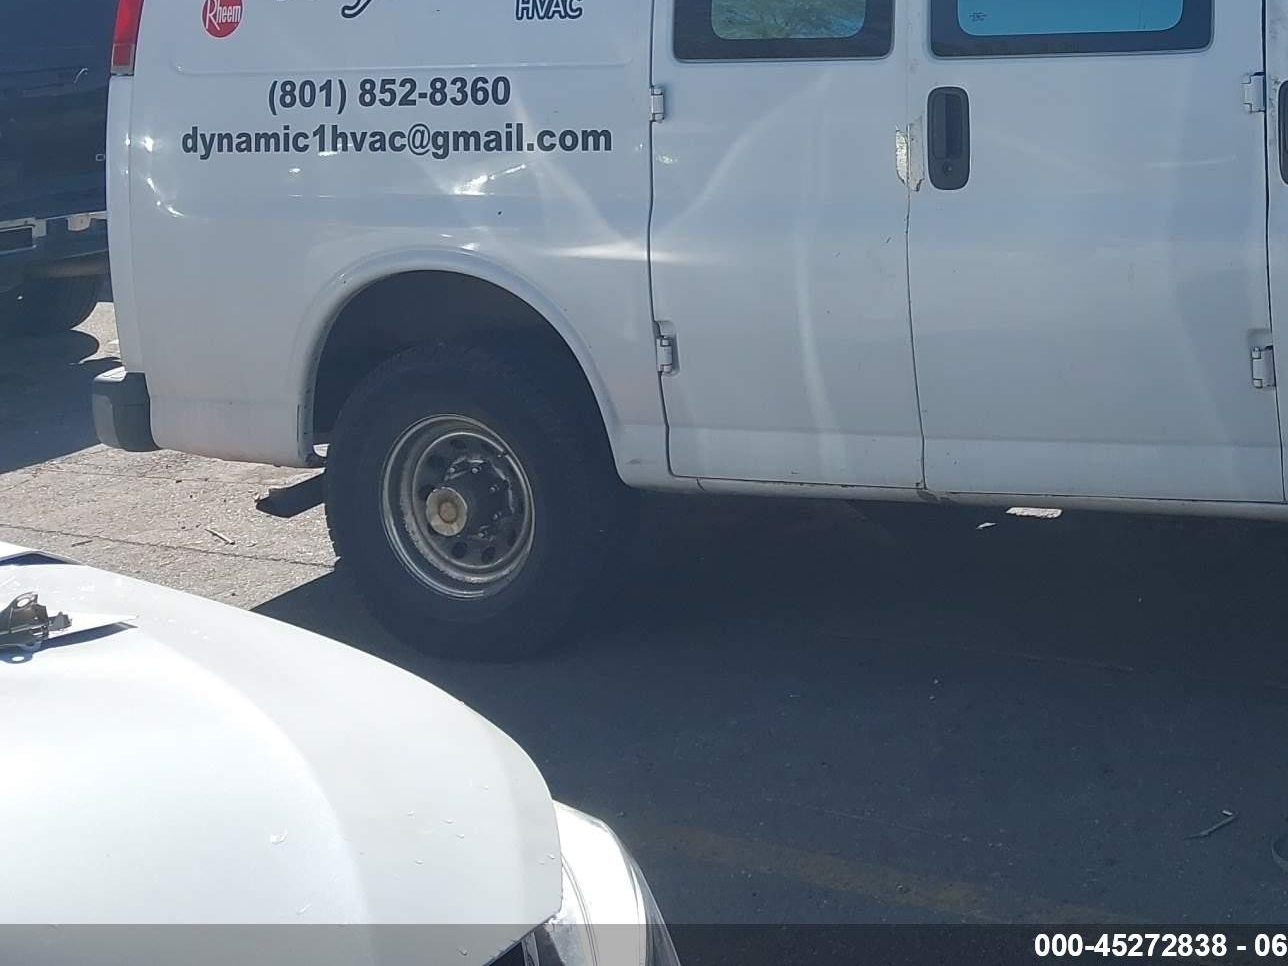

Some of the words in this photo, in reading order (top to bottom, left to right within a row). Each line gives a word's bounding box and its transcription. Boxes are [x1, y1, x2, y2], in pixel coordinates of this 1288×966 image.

[268, 79, 348, 115] (801)
[358, 76, 511, 107] 852-8360
[181, 123, 612, 160] dynamic1hvac@gmail.com
